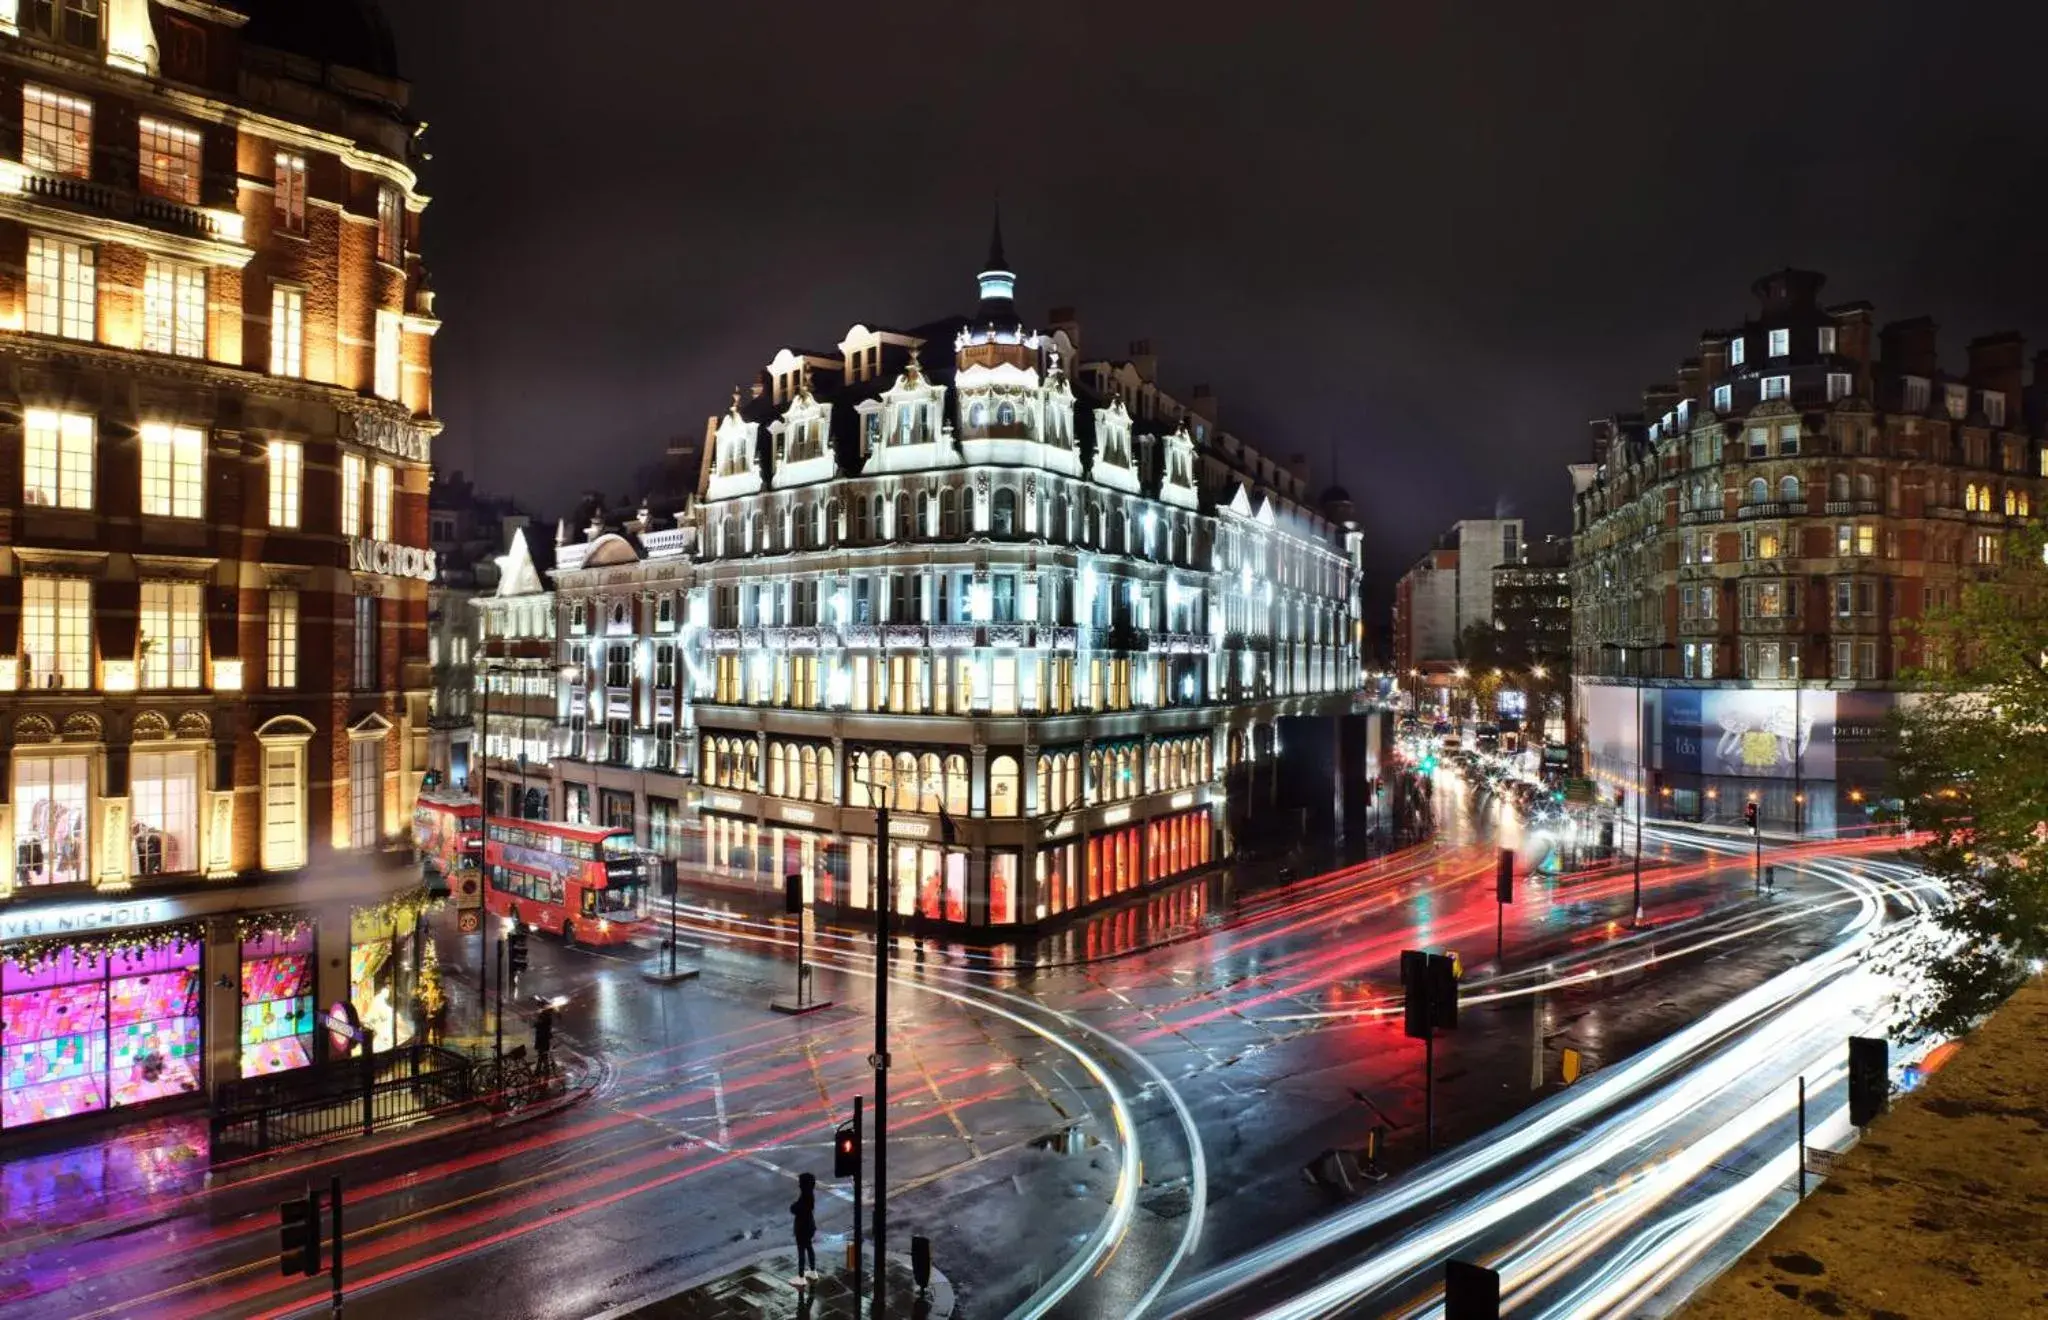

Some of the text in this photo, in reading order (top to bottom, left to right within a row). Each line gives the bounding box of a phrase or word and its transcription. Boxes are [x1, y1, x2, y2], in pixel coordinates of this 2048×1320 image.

[350, 536, 437, 582] NICHOLS
[2, 906, 150, 934] VEY NICHOLS
[461, 917, 476, 928] 20
